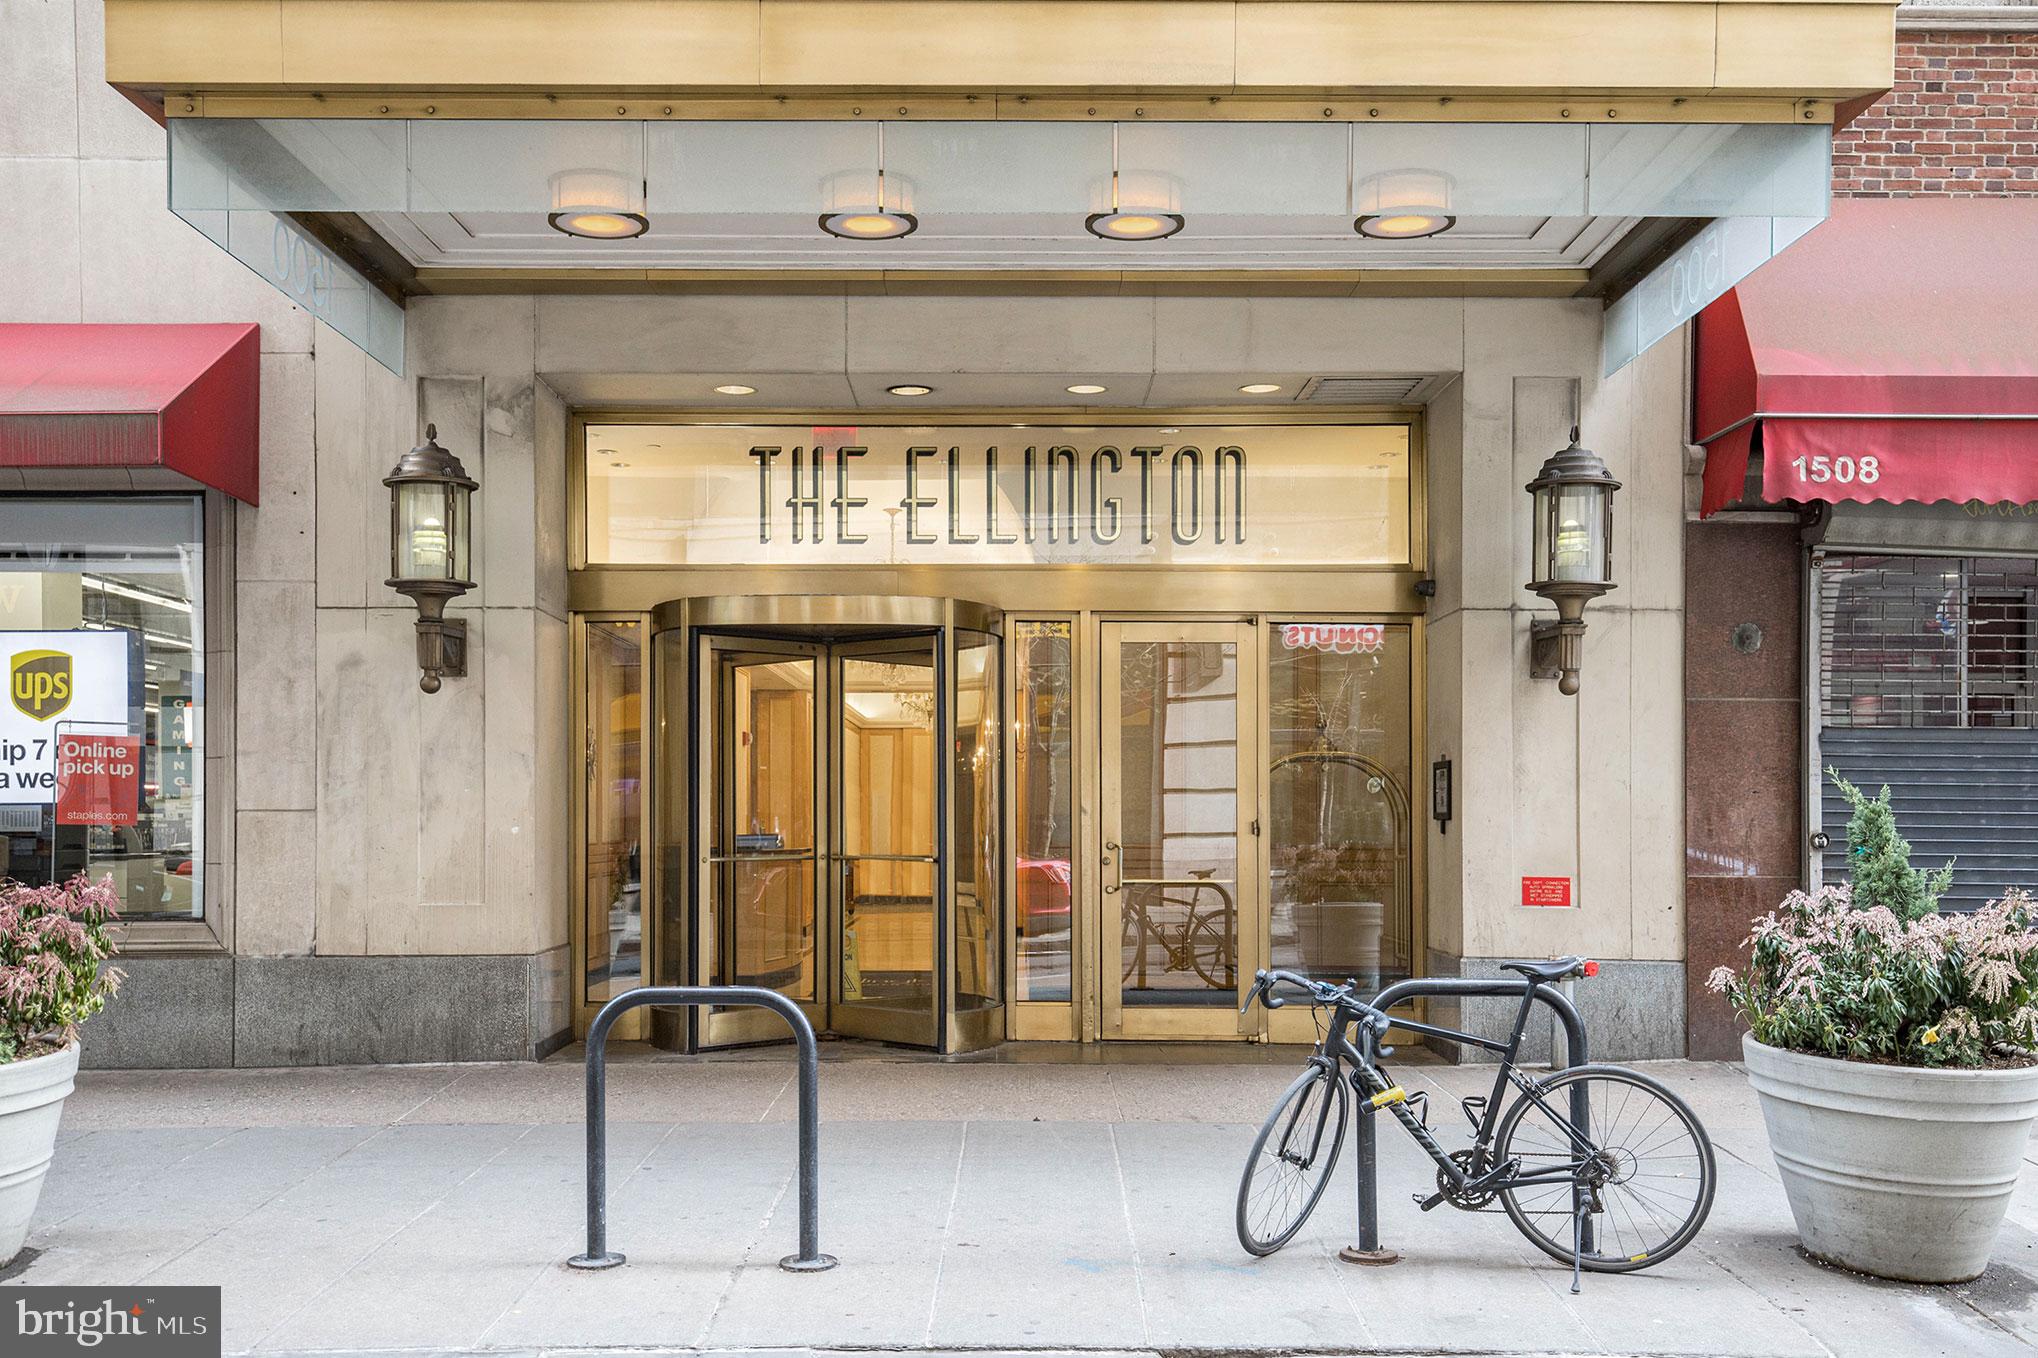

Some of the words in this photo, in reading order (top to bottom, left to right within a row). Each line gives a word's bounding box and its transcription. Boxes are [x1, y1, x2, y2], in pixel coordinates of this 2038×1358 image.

[1792, 455, 1880, 484] 1508
[749, 446, 868, 545] THE
[900, 446, 1247, 545] ELLINGTON
[15, 671, 69, 710] ups
[33, 739, 47, 760] 7
[64, 741, 127, 758] Online
[172, 699, 186, 786] GAMING
[63, 759, 105, 777] pick
[110, 763, 134, 778] up
[67, 811, 128, 821] staples.com
